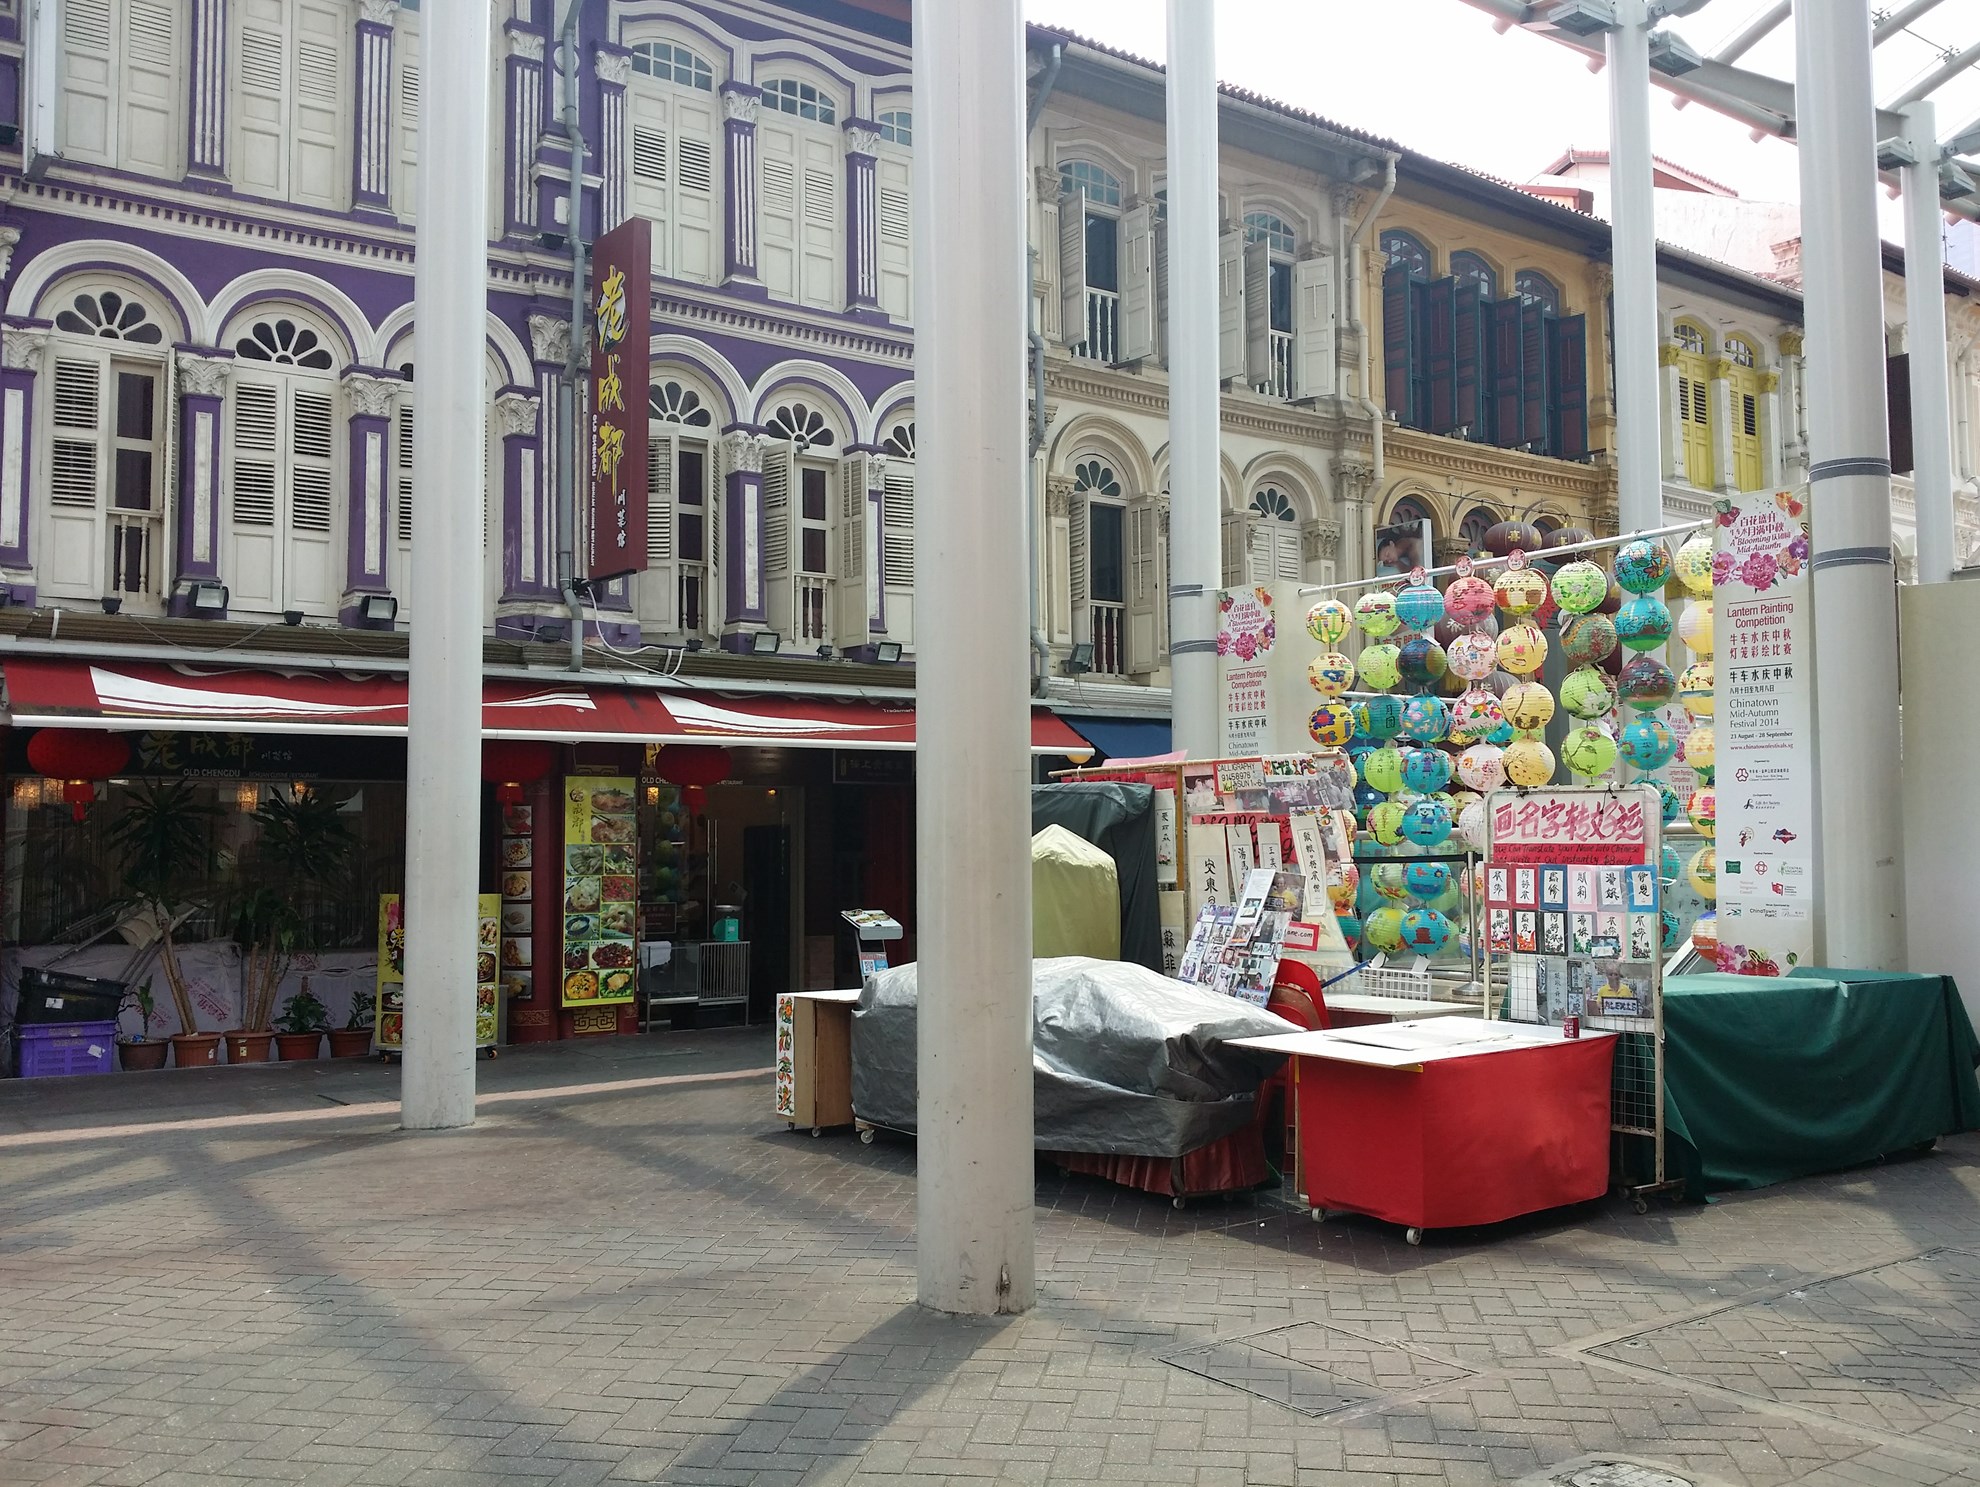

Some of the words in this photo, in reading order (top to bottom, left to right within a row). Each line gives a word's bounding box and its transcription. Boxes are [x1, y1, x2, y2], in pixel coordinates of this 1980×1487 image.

[1737, 533, 1770, 546] Blooming
[1737, 542, 1781, 554] Mid-Autumn
[1727, 607, 1758, 618] Lantern
[1761, 602, 1793, 614] Painting
[1735, 615, 1785, 628] Competition
[1730, 628, 1792, 646] 牛车水庆中秋
[1730, 643, 1792, 659] 灯笼彩绘比赛
[1227, 673, 1245, 681] Lantern
[1247, 670, 1267, 678] Painting
[1729, 666, 1793, 683] 牛车水庆中秋
[1232, 680, 1262, 689] Competition
[1729, 698, 1779, 709] Chinatown
[1729, 709, 1779, 719] Mid-Autumn
[1730, 718, 1757, 728] Festival
[1759, 718, 1779, 727] 2014
[1738, 732, 1754, 740] August
[1228, 742, 1258, 750] Chinatown
[183, 768, 200, 777] OLD
[201, 769, 240, 777] CHENGDU
[1217, 763, 1255, 772] CALLIGRAPHY
[641, 776, 654, 784] OLD
[1611, 843, 1640, 853] Chinese
